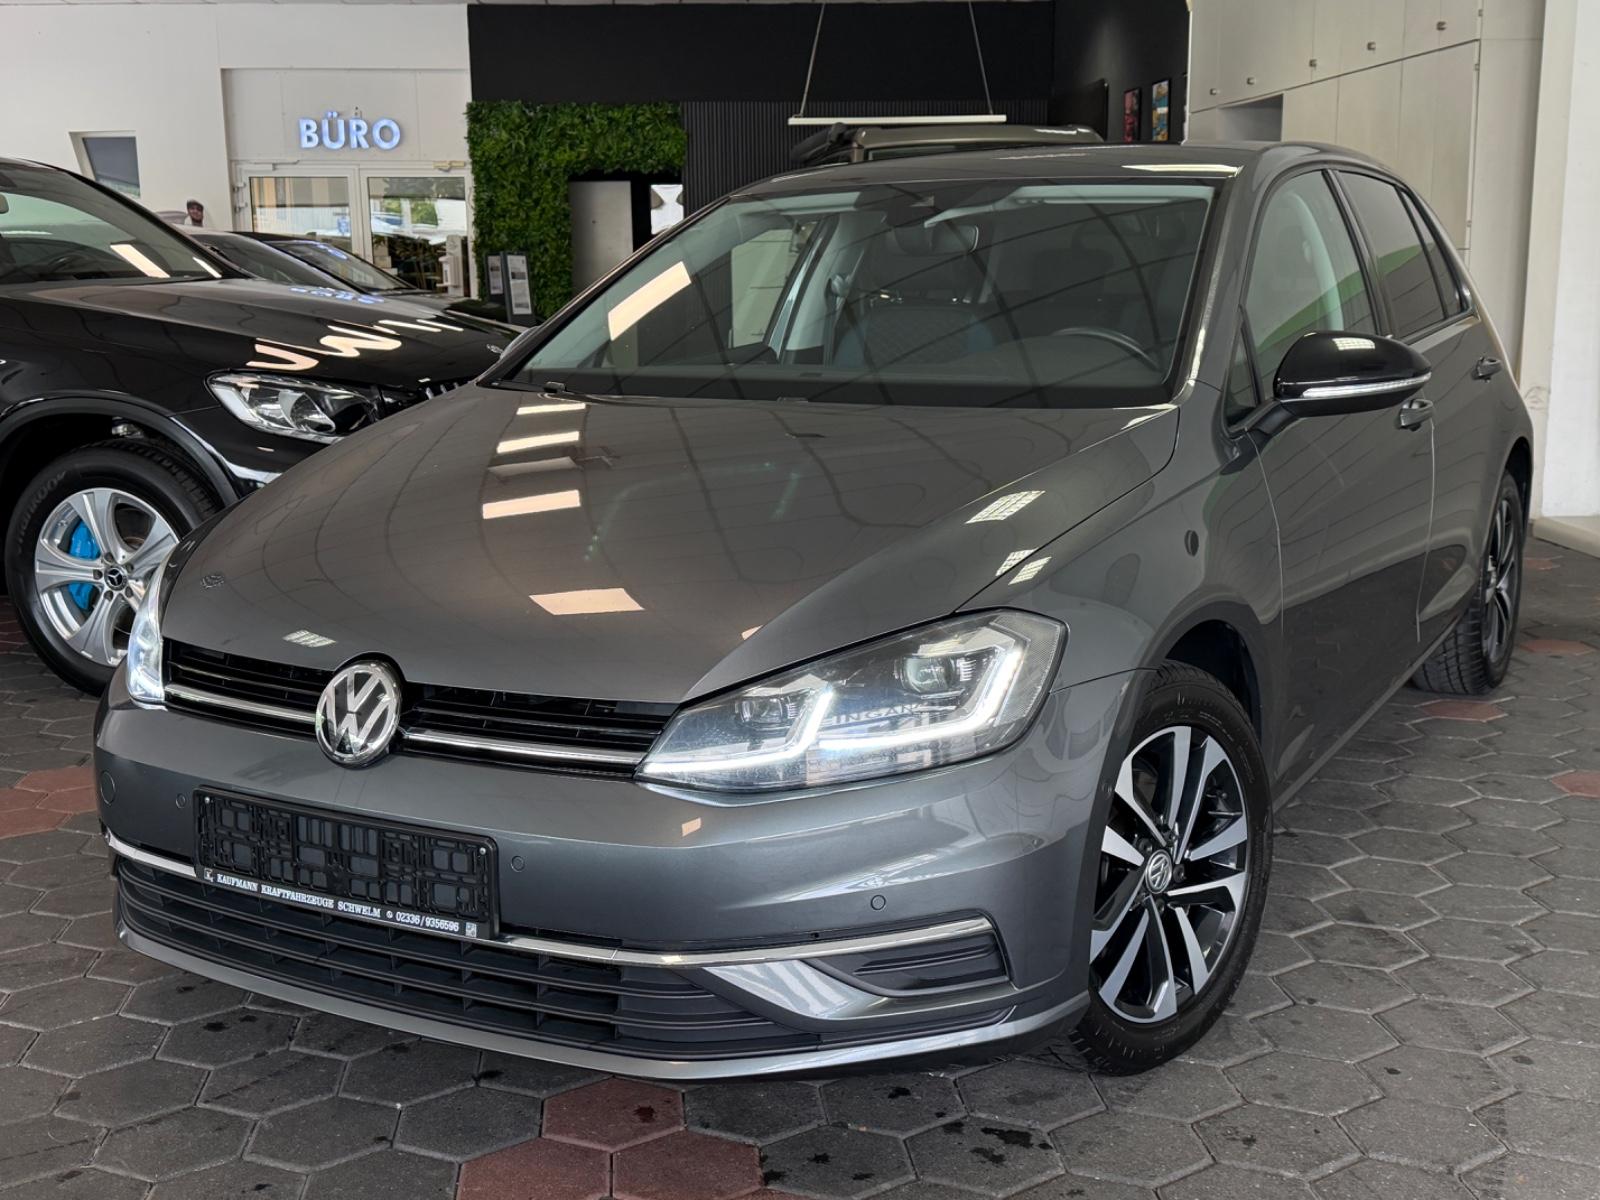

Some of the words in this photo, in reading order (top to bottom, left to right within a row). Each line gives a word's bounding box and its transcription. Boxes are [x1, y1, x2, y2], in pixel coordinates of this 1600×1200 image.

[299, 111, 401, 149] BÜRO
[217, 873, 258, 892] KAUFMANN
[260, 884, 335, 909] KRAFTFAHRZEUGE
[337, 901, 381, 918] SCHWELM
